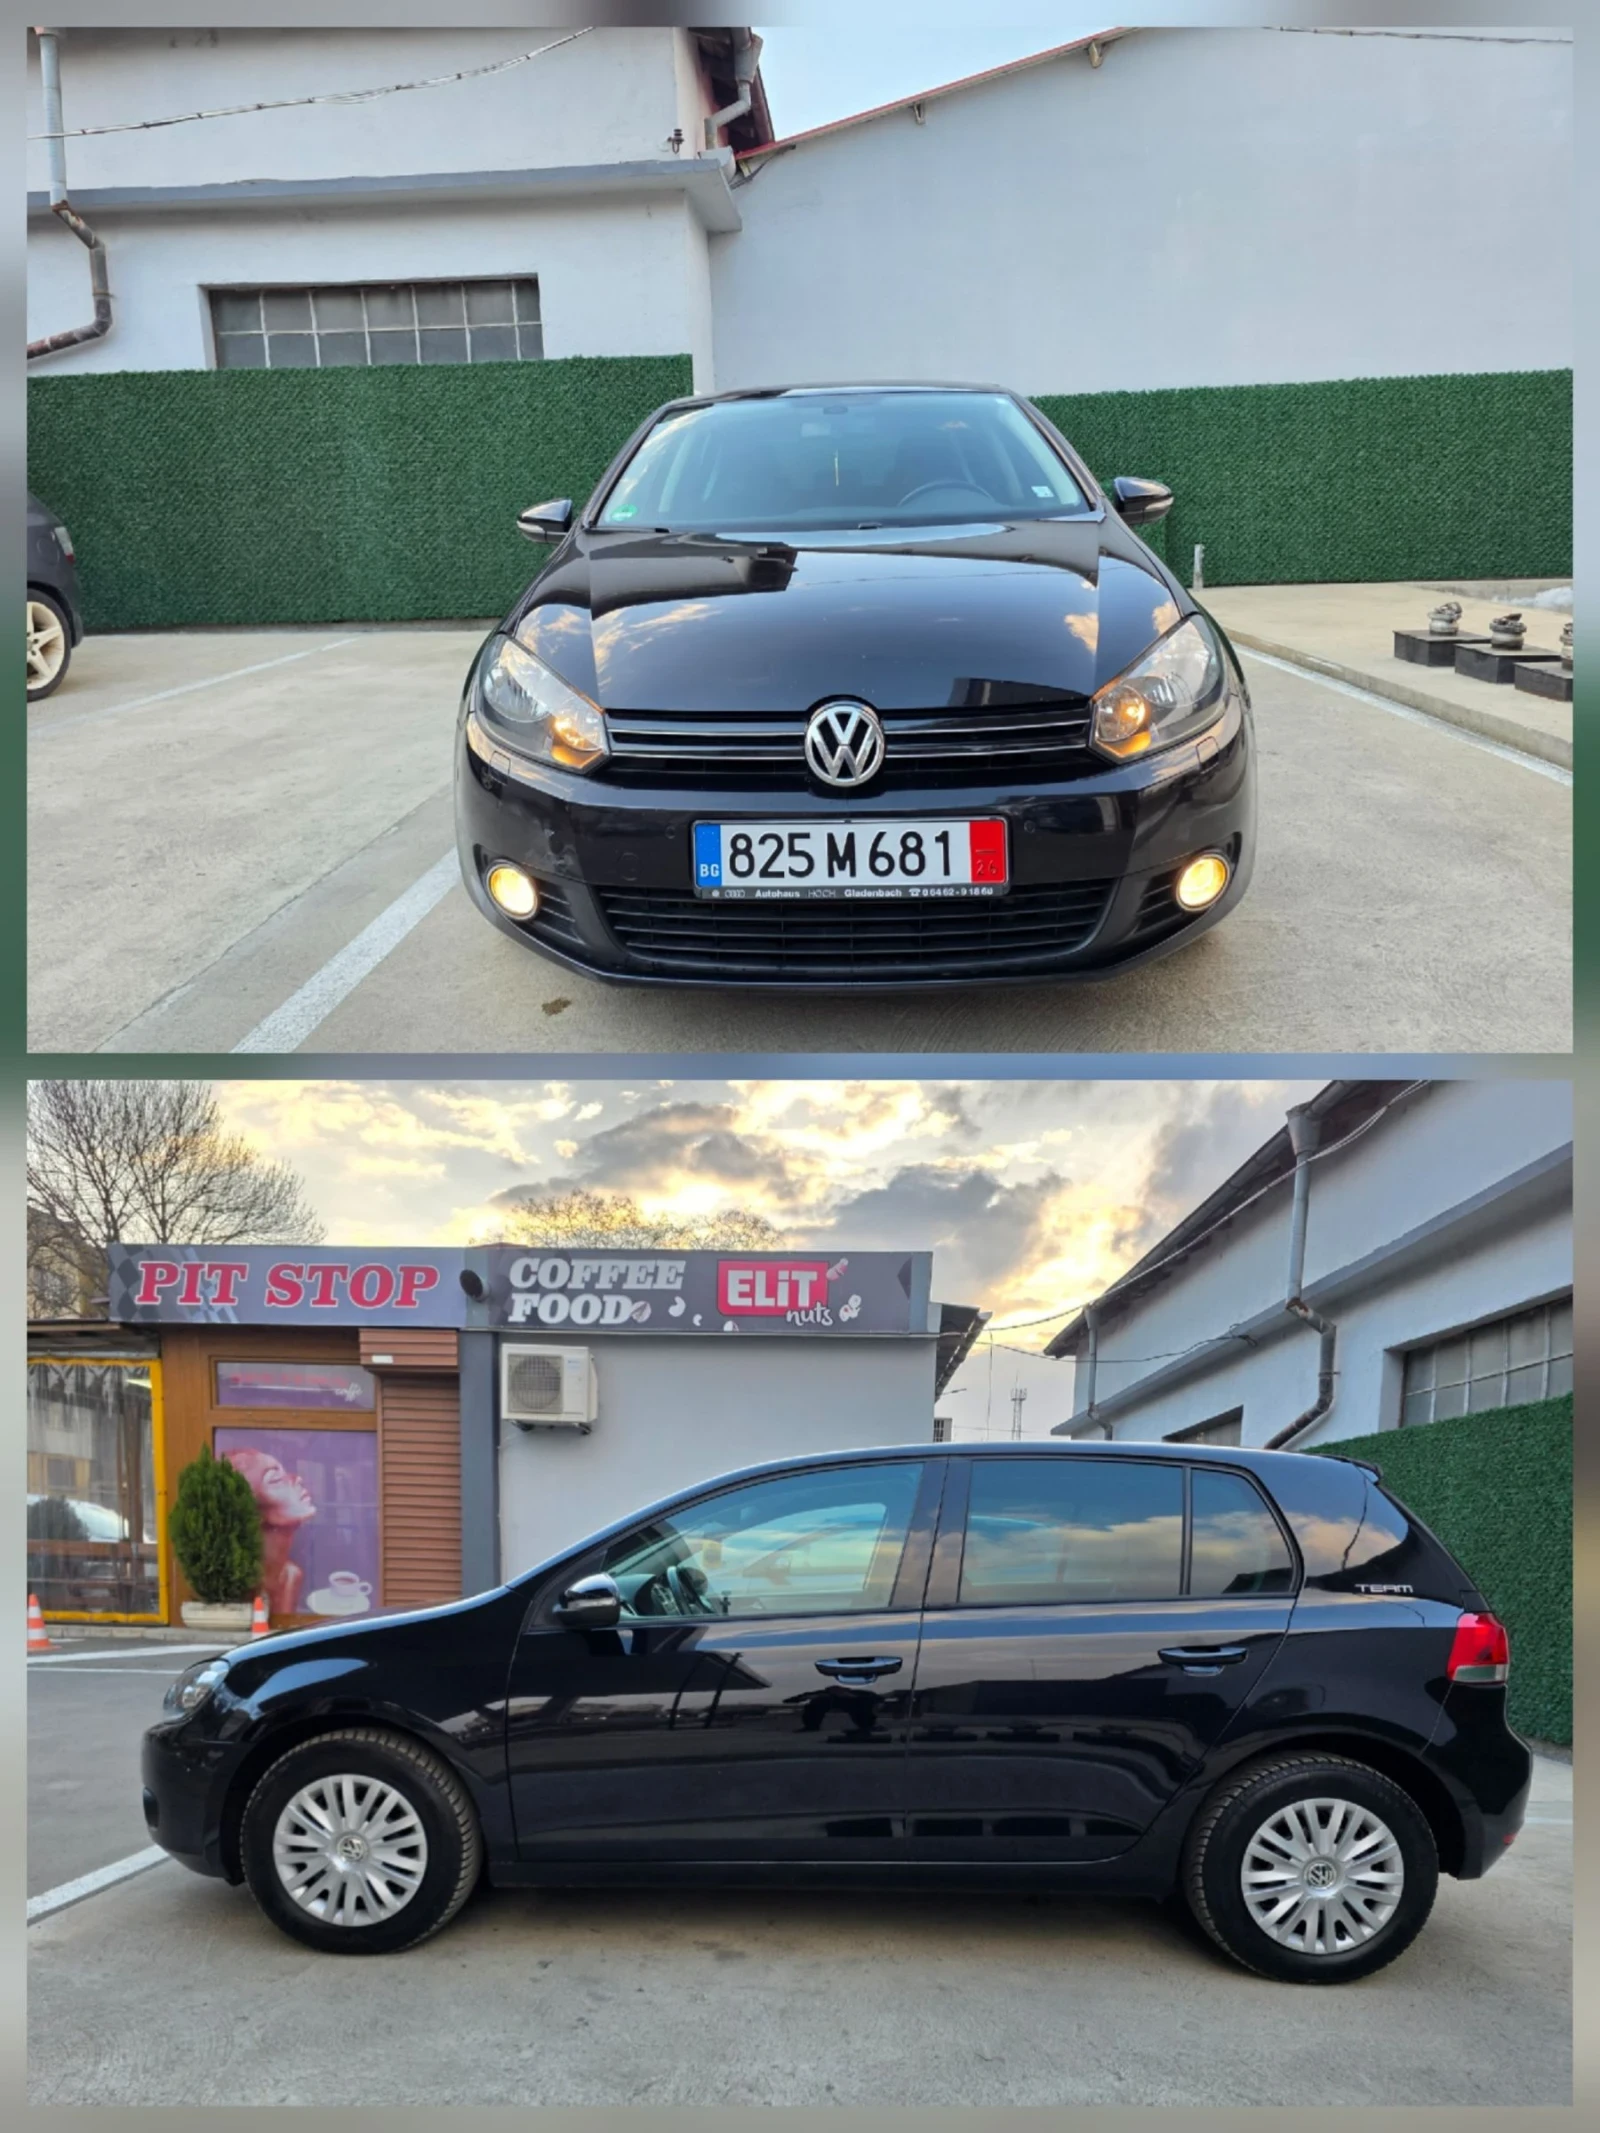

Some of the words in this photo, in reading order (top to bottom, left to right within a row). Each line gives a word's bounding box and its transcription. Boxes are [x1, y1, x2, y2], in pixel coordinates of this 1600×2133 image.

[699, 863, 720, 878] BG
[755, 889, 801, 898] Autohaus
[844, 888, 903, 898] Gladenbach
[134, 1261, 248, 1306] PIT
[264, 1262, 440, 1309] STOP
[508, 1257, 686, 1290] COFFEE
[508, 1293, 633, 1324] FOOD
[786, 1301, 833, 1326] nuts
[1354, 1584, 1414, 1593] TEAM
